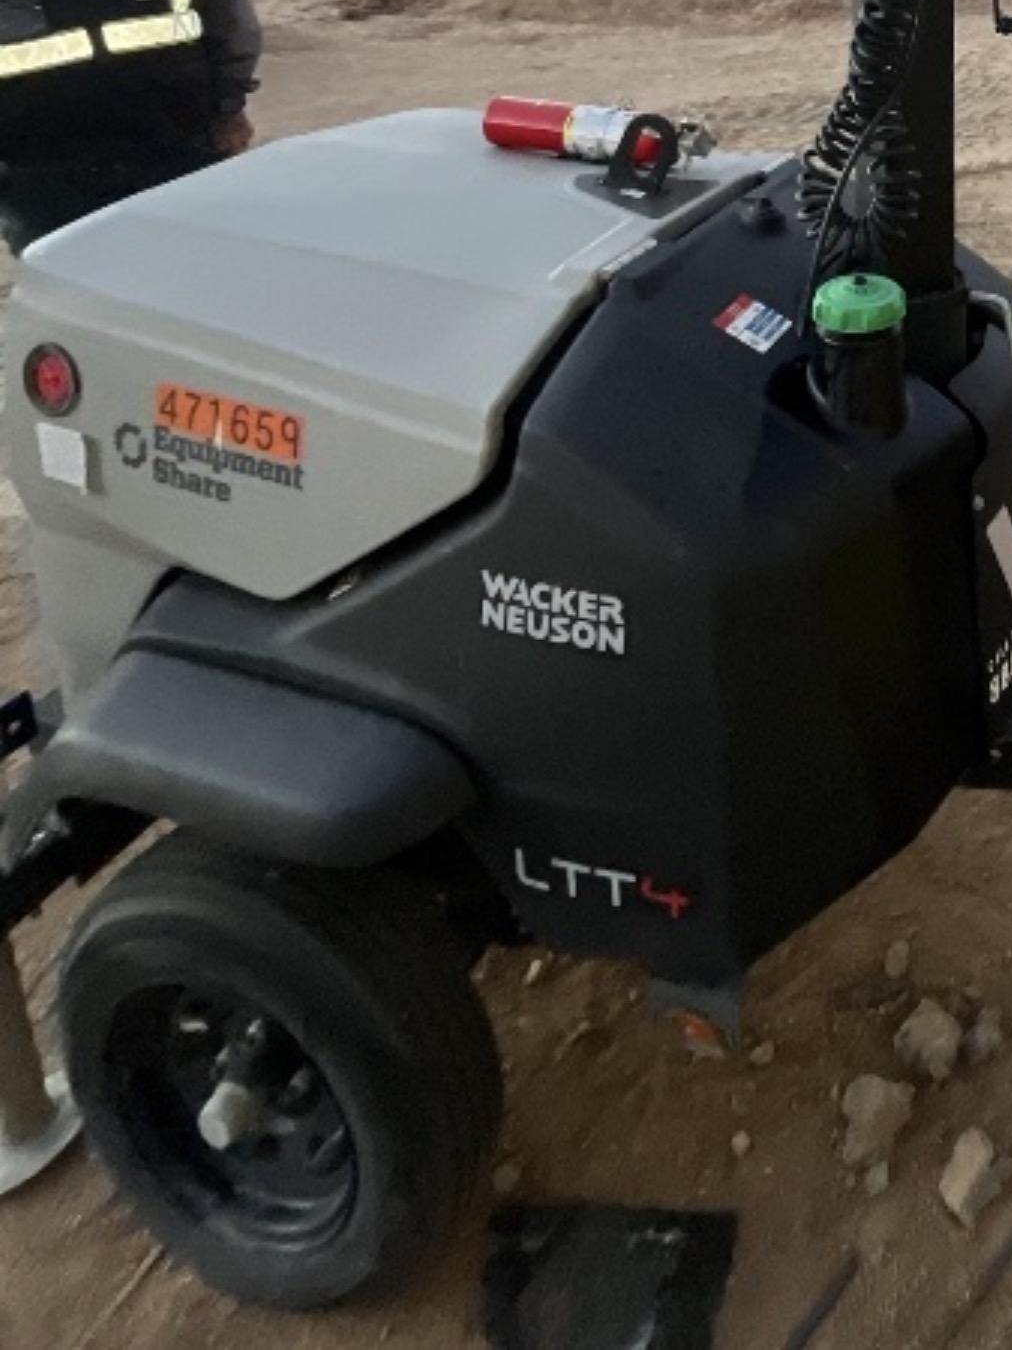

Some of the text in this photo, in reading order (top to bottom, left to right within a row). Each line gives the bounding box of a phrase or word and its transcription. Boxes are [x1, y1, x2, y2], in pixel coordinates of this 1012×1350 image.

[159, 388, 300, 459] 471659
[152, 456, 232, 502] Share
[153, 425, 304, 490] Equipment
[480, 568, 625, 626] WACKER
[480, 599, 626, 655] NEUSON
